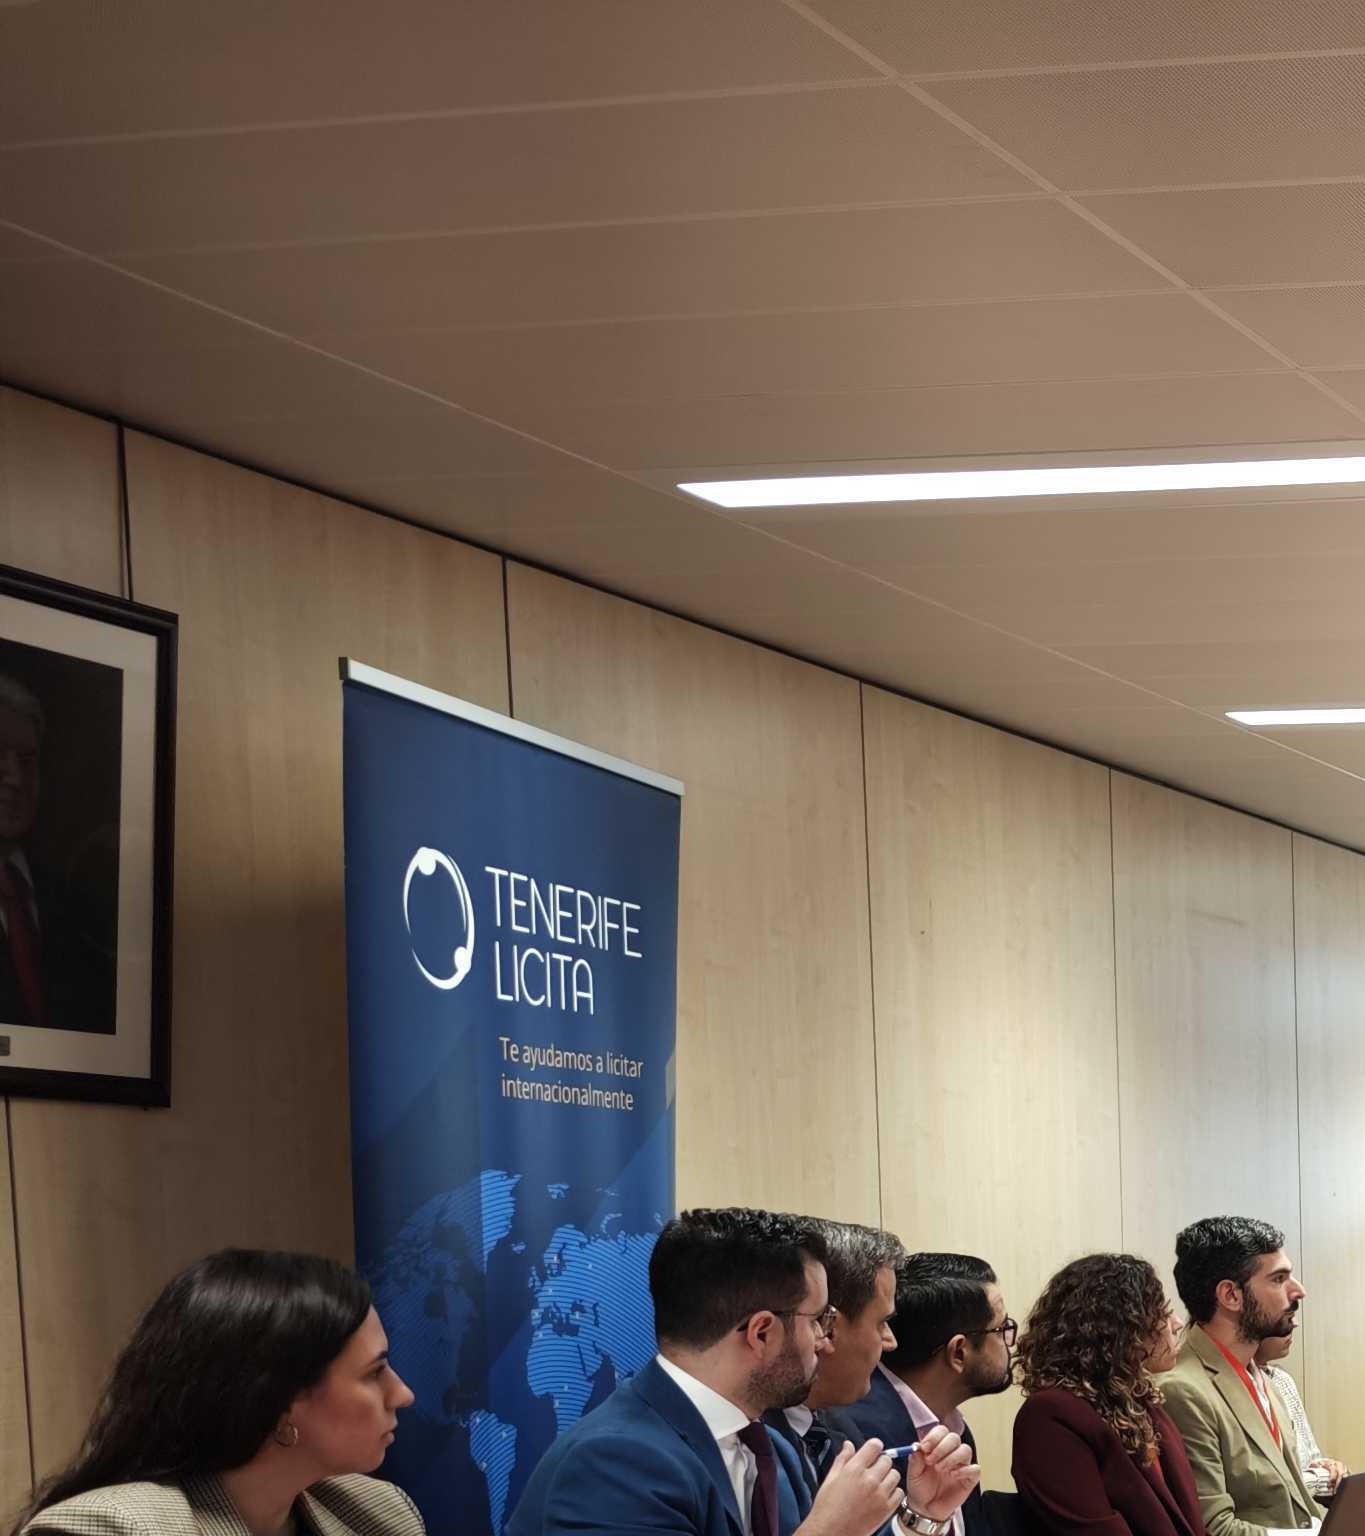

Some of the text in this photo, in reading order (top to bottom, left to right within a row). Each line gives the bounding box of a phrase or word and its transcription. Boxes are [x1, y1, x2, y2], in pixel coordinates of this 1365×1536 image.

[485, 865, 643, 958] TENERIFE
[494, 940, 594, 1016] LICITA
[499, 1036, 644, 1079] Te ayudamos a licitar
[501, 1073, 634, 1111] internacionalmente
